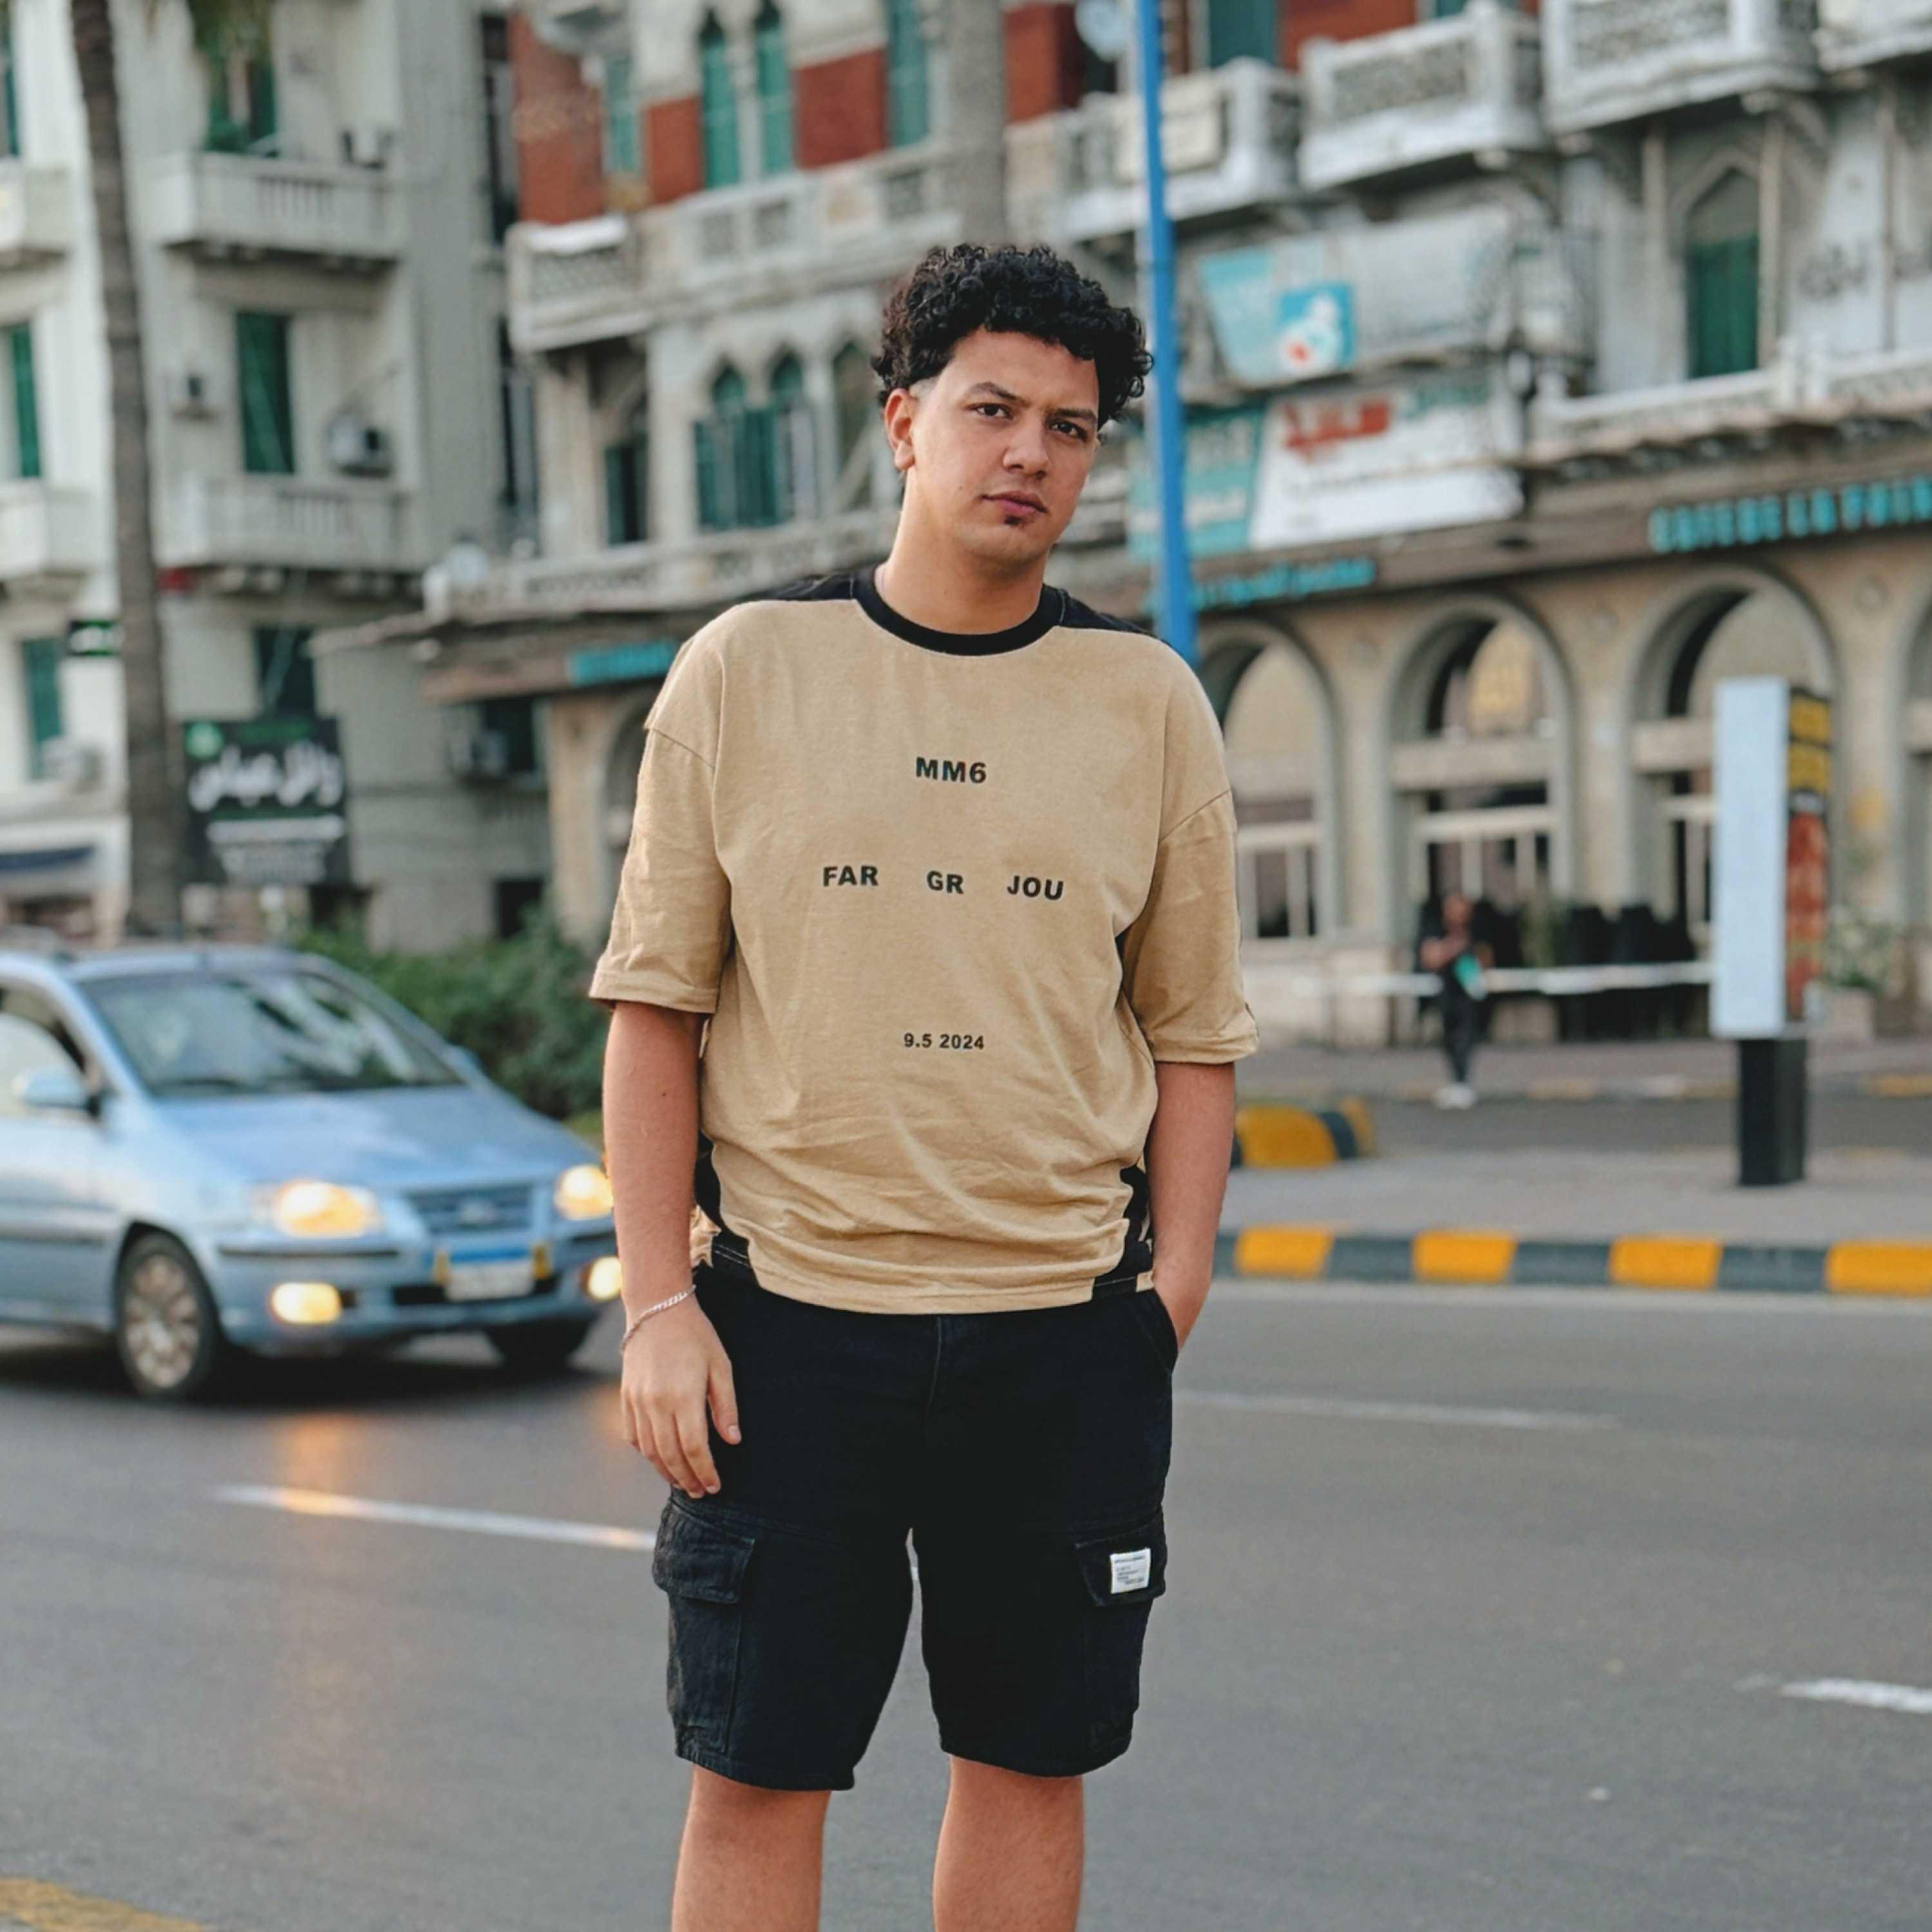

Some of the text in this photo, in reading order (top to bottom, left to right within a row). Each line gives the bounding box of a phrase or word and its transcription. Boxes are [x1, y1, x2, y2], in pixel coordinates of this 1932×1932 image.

[916, 757, 987, 784] MM6
[822, 865, 1064, 901] FAR GR JOU
[904, 1032, 985, 1050] 9.5 2024
